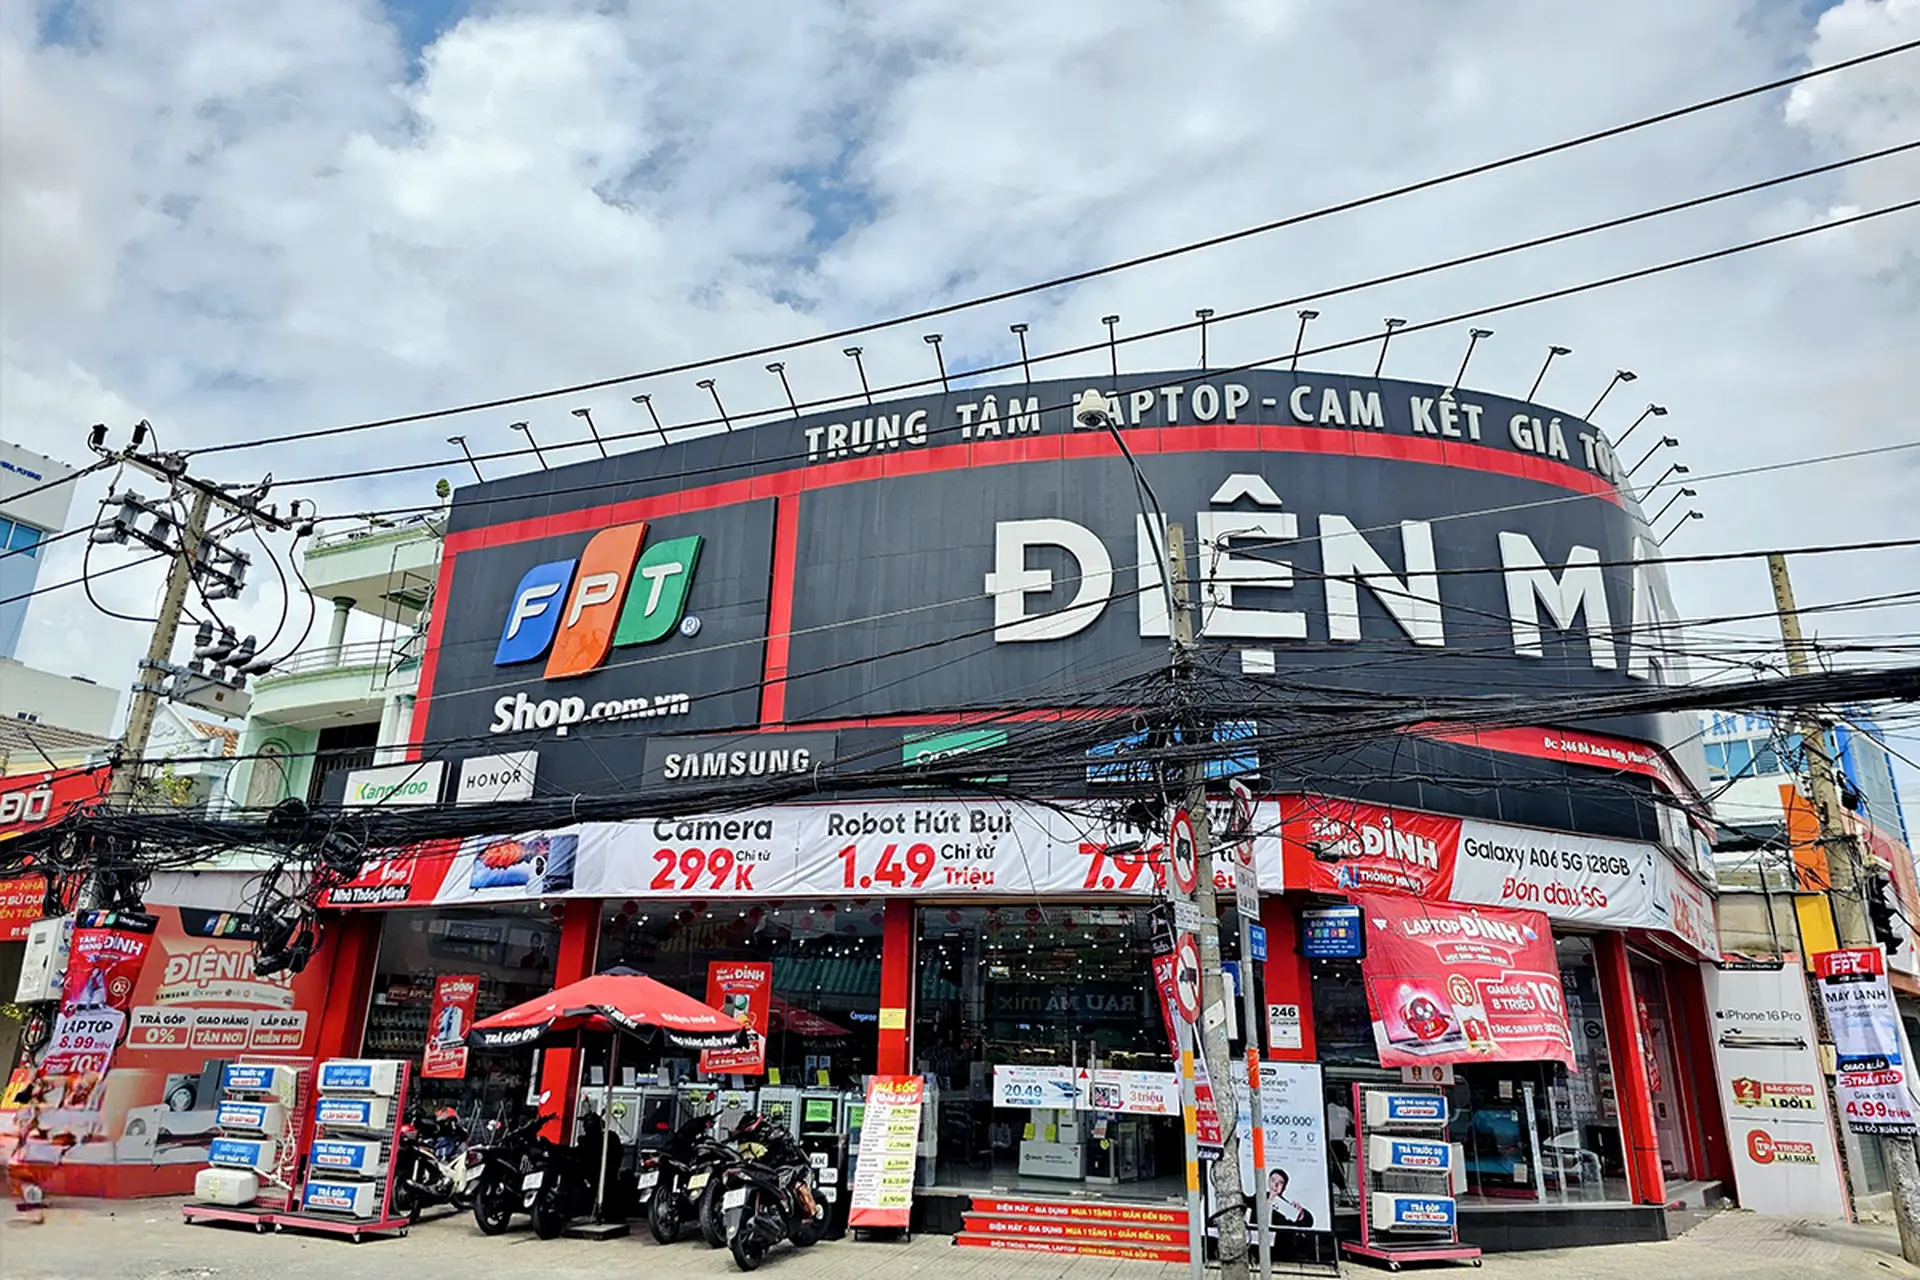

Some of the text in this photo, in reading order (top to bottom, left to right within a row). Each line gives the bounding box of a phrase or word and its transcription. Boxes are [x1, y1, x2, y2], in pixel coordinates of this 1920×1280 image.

[805, 409, 929, 461] TRUNG
[956, 395, 1041, 441] TÂM
[1073, 383, 1250, 429] LAPTOP
[1289, 384, 1385, 429] CAM
[1411, 387, 1484, 442] KẾT
[1510, 418, 1570, 461] GIÁ
[985, 474, 1447, 675] ĐIỆN
[490, 691, 690, 737] Shop.com.vn
[663, 748, 810, 779] SAMSUNG
[466, 769, 522, 790] HONOR
[653, 818, 773, 841] Camera
[827, 809, 1013, 841] Robot Hút Bụi
[940, 843, 996, 861] Chỉ từ
[1361, 815, 1438, 871] ĐỈNH
[735, 850, 771, 862] Chỉ từ
[838, 843, 937, 889] 1.49
[1464, 837, 1631, 876] Galaxy A06 5G 128GB
[943, 867, 995, 890] Triệu
[1338, 865, 1360, 889] AI
[1502, 877, 1539, 899] Đón
[1582, 886, 1608, 909] 5G
[1402, 908, 1526, 945] LAPTOP ĐỈNH
[164, 947, 241, 987] ĐIỆN
[1831, 958, 1860, 974] FPT
[140, 1012, 187, 1025] TRẢ GÓP
[196, 1015, 249, 1026] GIAO HÀNG
[1271, 1006, 1296, 1017] 246
[1724, 1011, 1802, 1022] iPhone 16 Pro
[59, 1035, 95, 1049] 8.99
[145, 1028, 175, 1042] 0%
[196, 1031, 222, 1045] TẬN
[1004, 1083, 1043, 1097] 20.49
[1137, 1089, 1164, 1105] triệu
[1740, 1080, 1755, 1095] 2
[1846, 1101, 1887, 1118] 4.99
